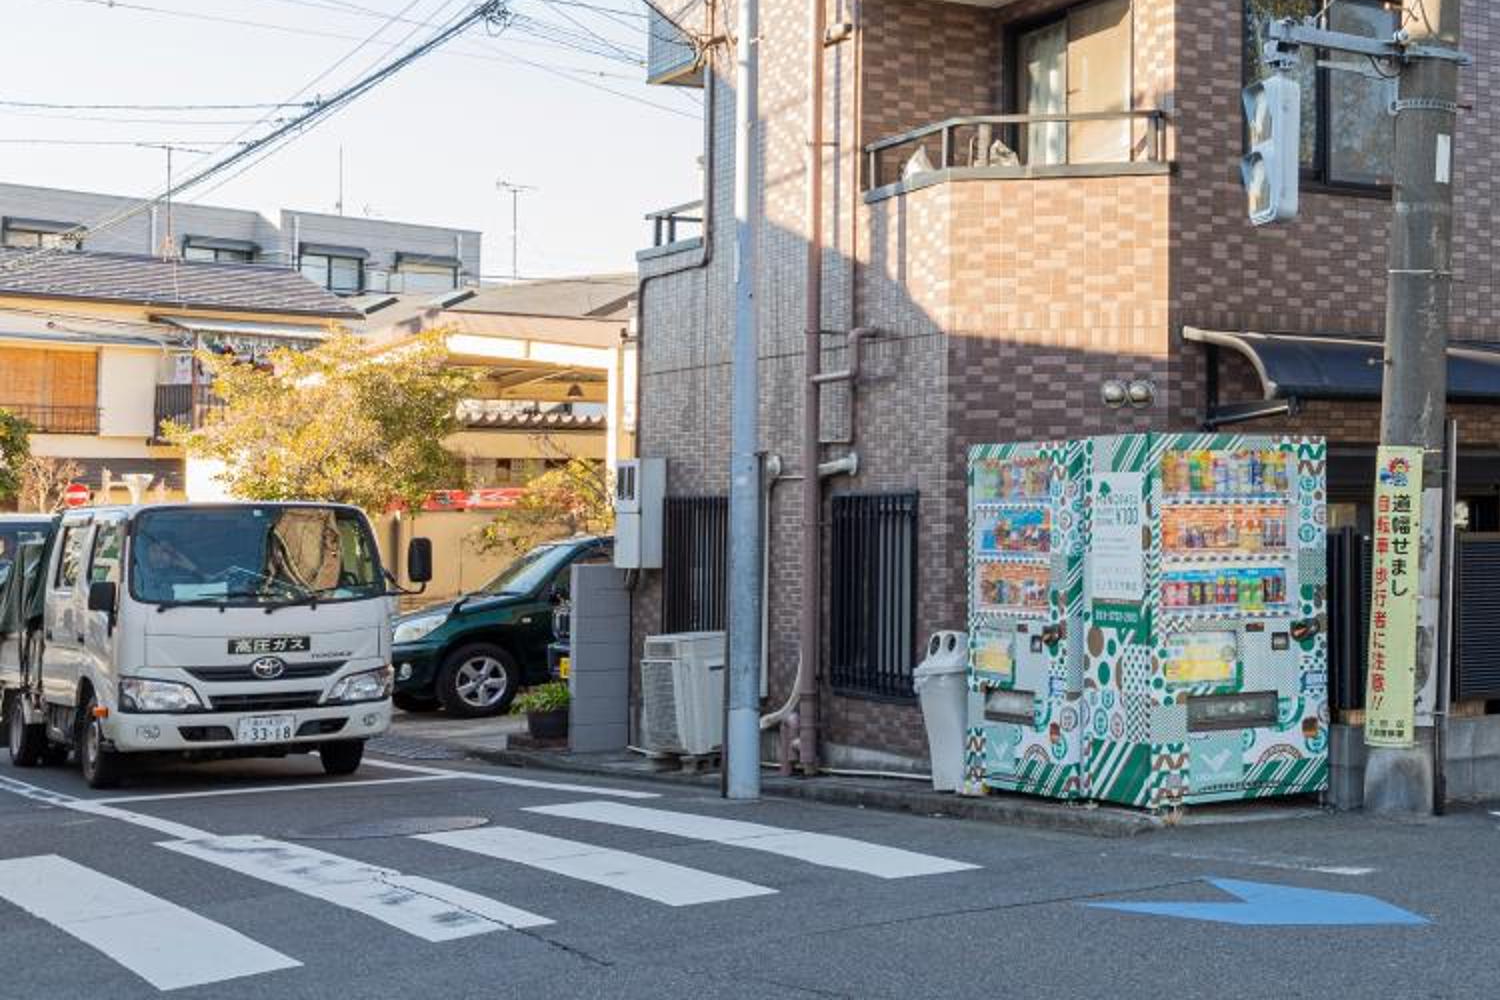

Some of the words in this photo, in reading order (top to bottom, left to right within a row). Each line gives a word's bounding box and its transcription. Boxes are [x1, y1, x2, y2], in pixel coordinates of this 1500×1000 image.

[1392, 494, 1411, 597] 道幅せまし
[235, 638, 305, 653] 高圧ガス
